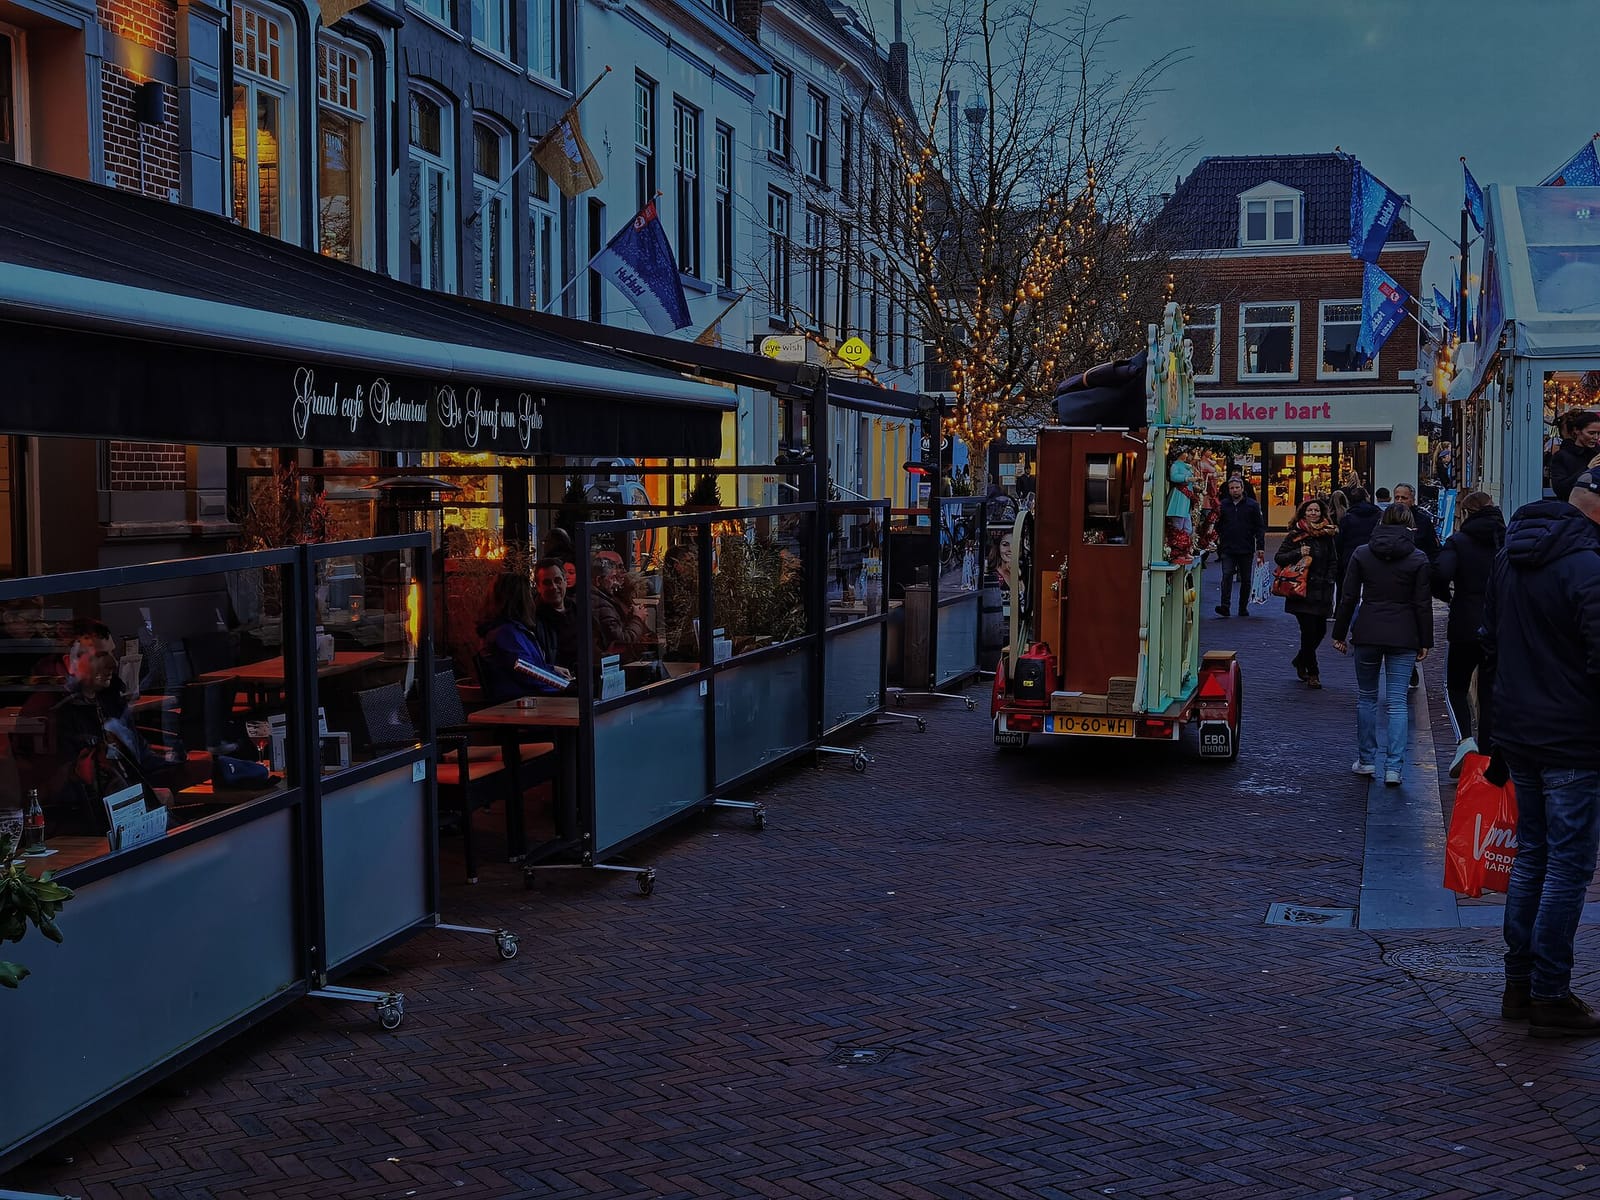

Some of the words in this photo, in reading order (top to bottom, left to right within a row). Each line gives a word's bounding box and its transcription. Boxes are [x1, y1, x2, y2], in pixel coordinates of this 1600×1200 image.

[293, 366, 338, 440] Grand
[369, 377, 428, 426] Restaurant
[1201, 402, 1278, 420] bakker
[1284, 401, 1331, 419] bart
[1058, 717, 1127, 733] 10-60-WH
[1204, 734, 1226, 745] EBO
